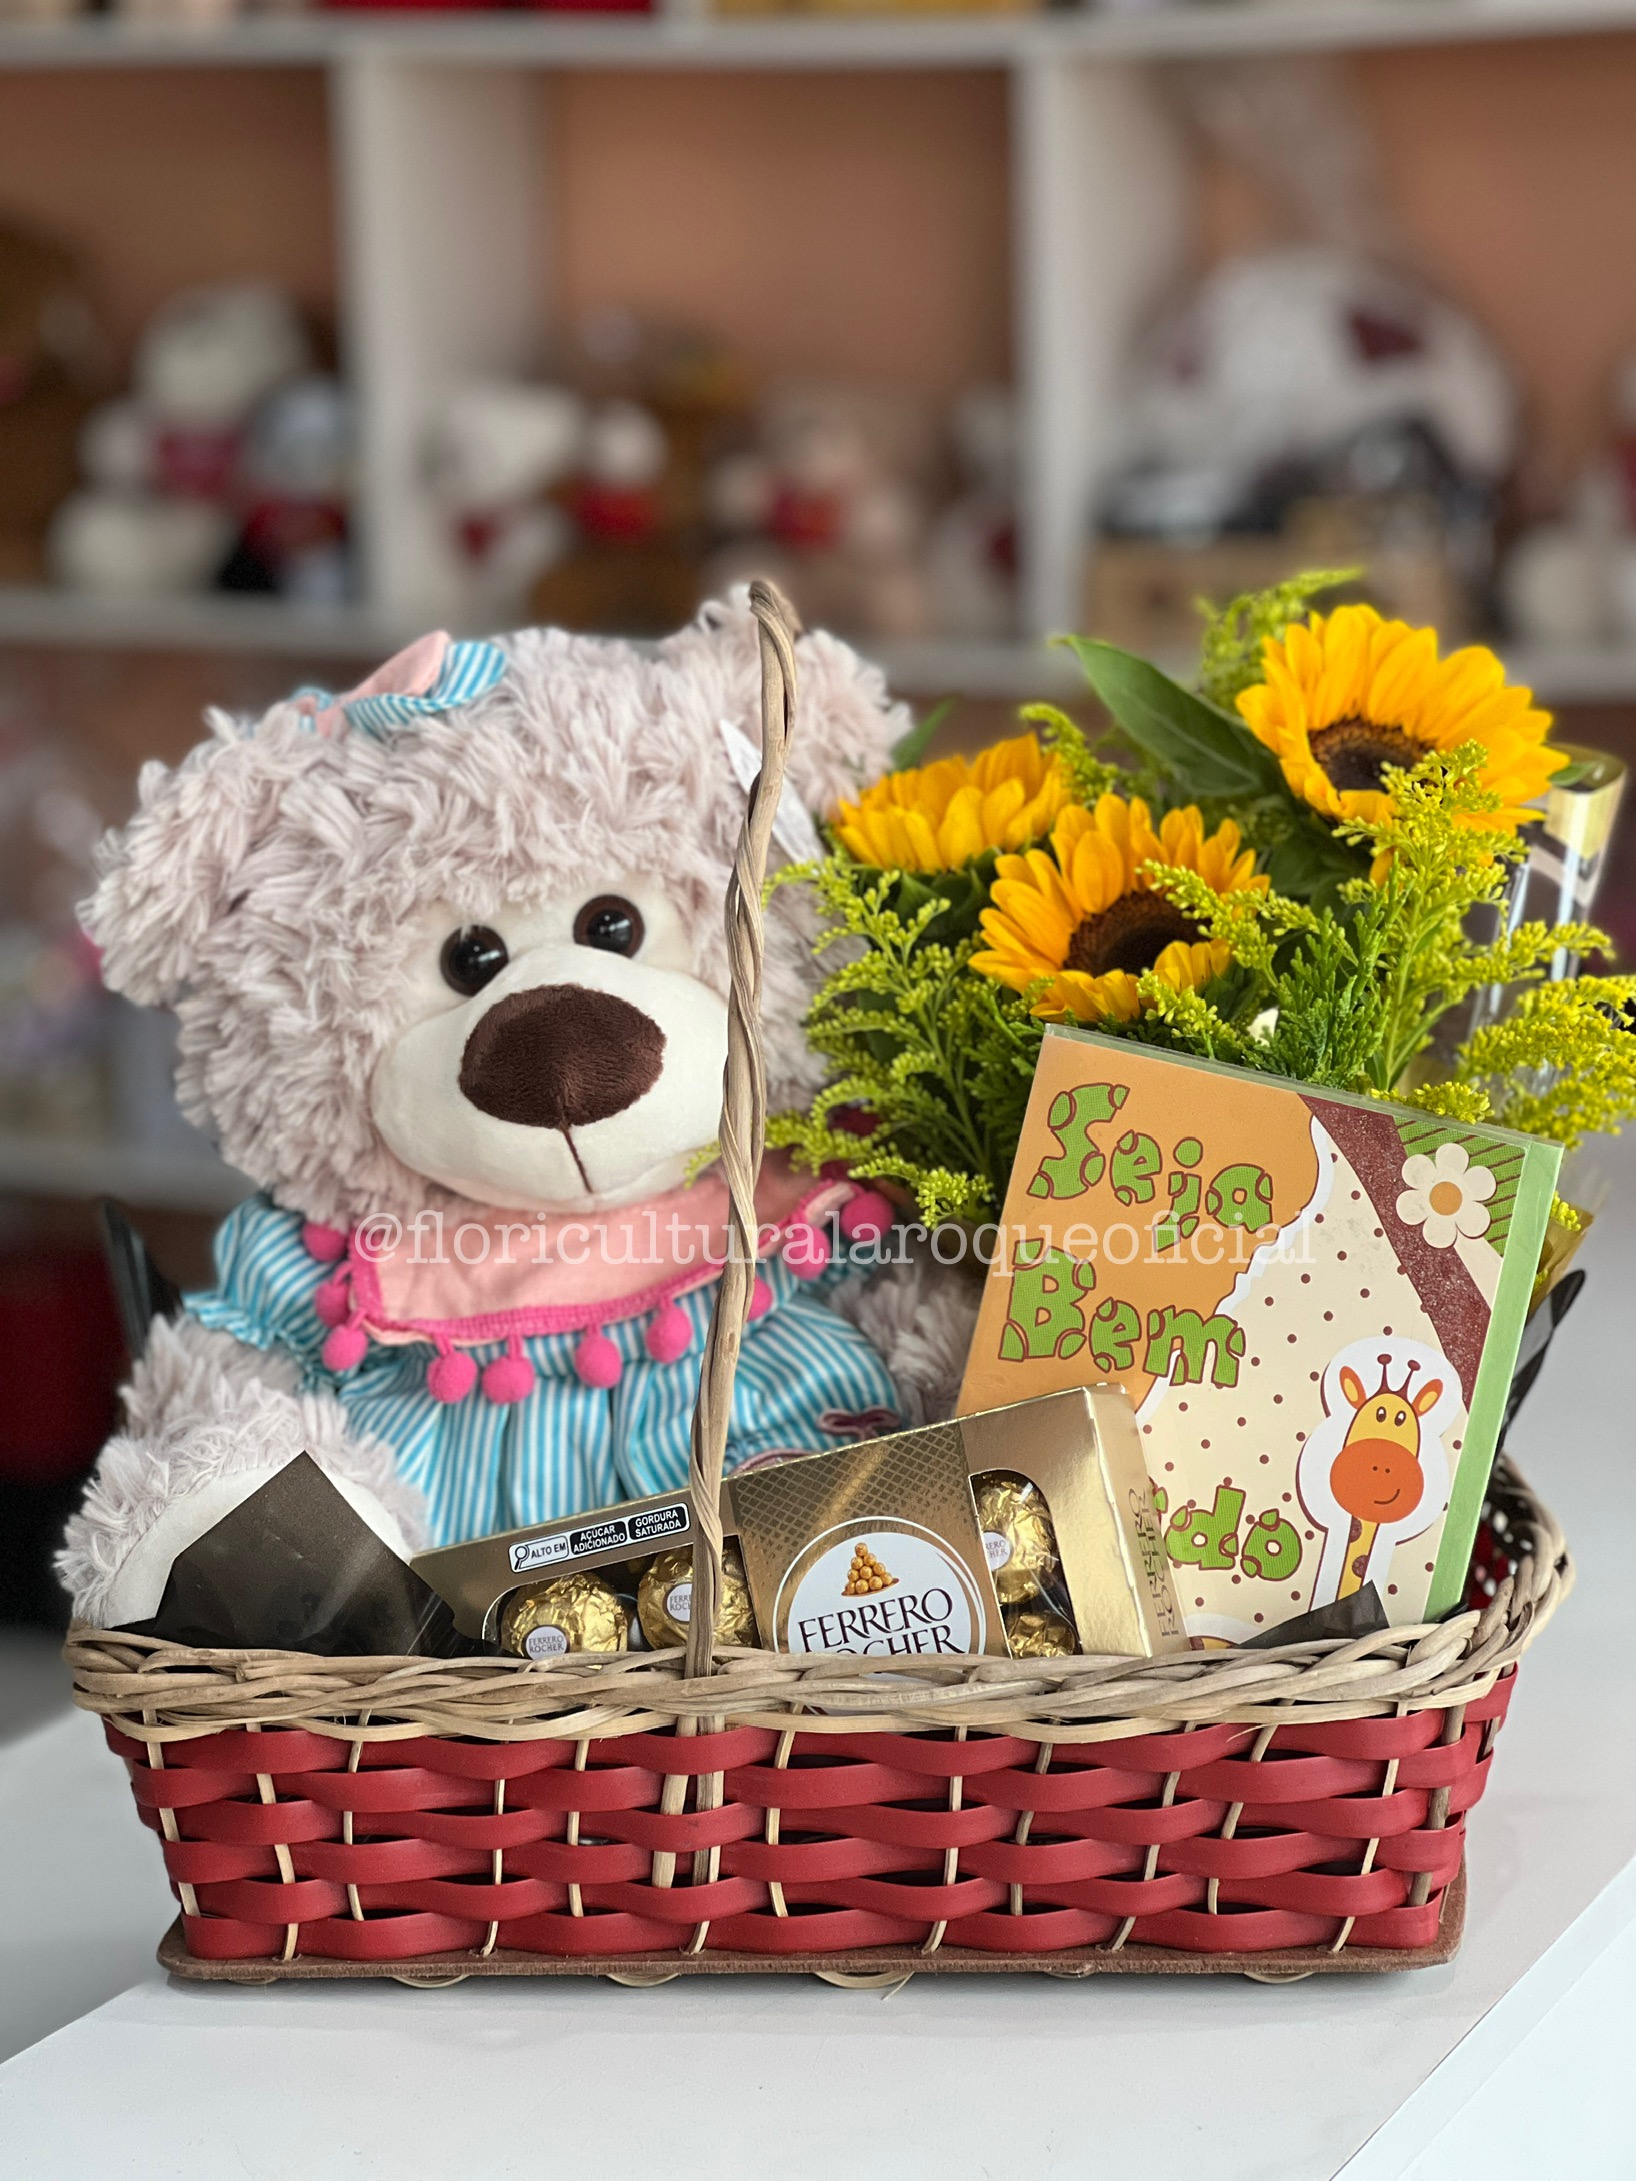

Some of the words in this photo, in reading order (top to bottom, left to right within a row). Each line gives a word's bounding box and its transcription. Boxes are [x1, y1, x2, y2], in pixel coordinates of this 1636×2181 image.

[1026, 1082, 1273, 1252] Seja
[998, 1237, 1246, 1388] Bem
[635, 1509, 679, 1528] GORDURA
[580, 1524, 616, 1542] AÇÚCAR
[635, 1519, 682, 1538] SATURADA
[1149, 1476, 1303, 1581] do
[531, 1545, 552, 1560] ALTO
[553, 1541, 567, 1553] EM
[573, 1533, 626, 1554] ADICIONADO
[1129, 1488, 1170, 1637] FERRERO
[670, 1594, 691, 1605] FERR
[798, 1588, 953, 1653] FERRERO
[529, 1635, 564, 1647] FERRERO
[529, 1643, 565, 1654] ROCHER
